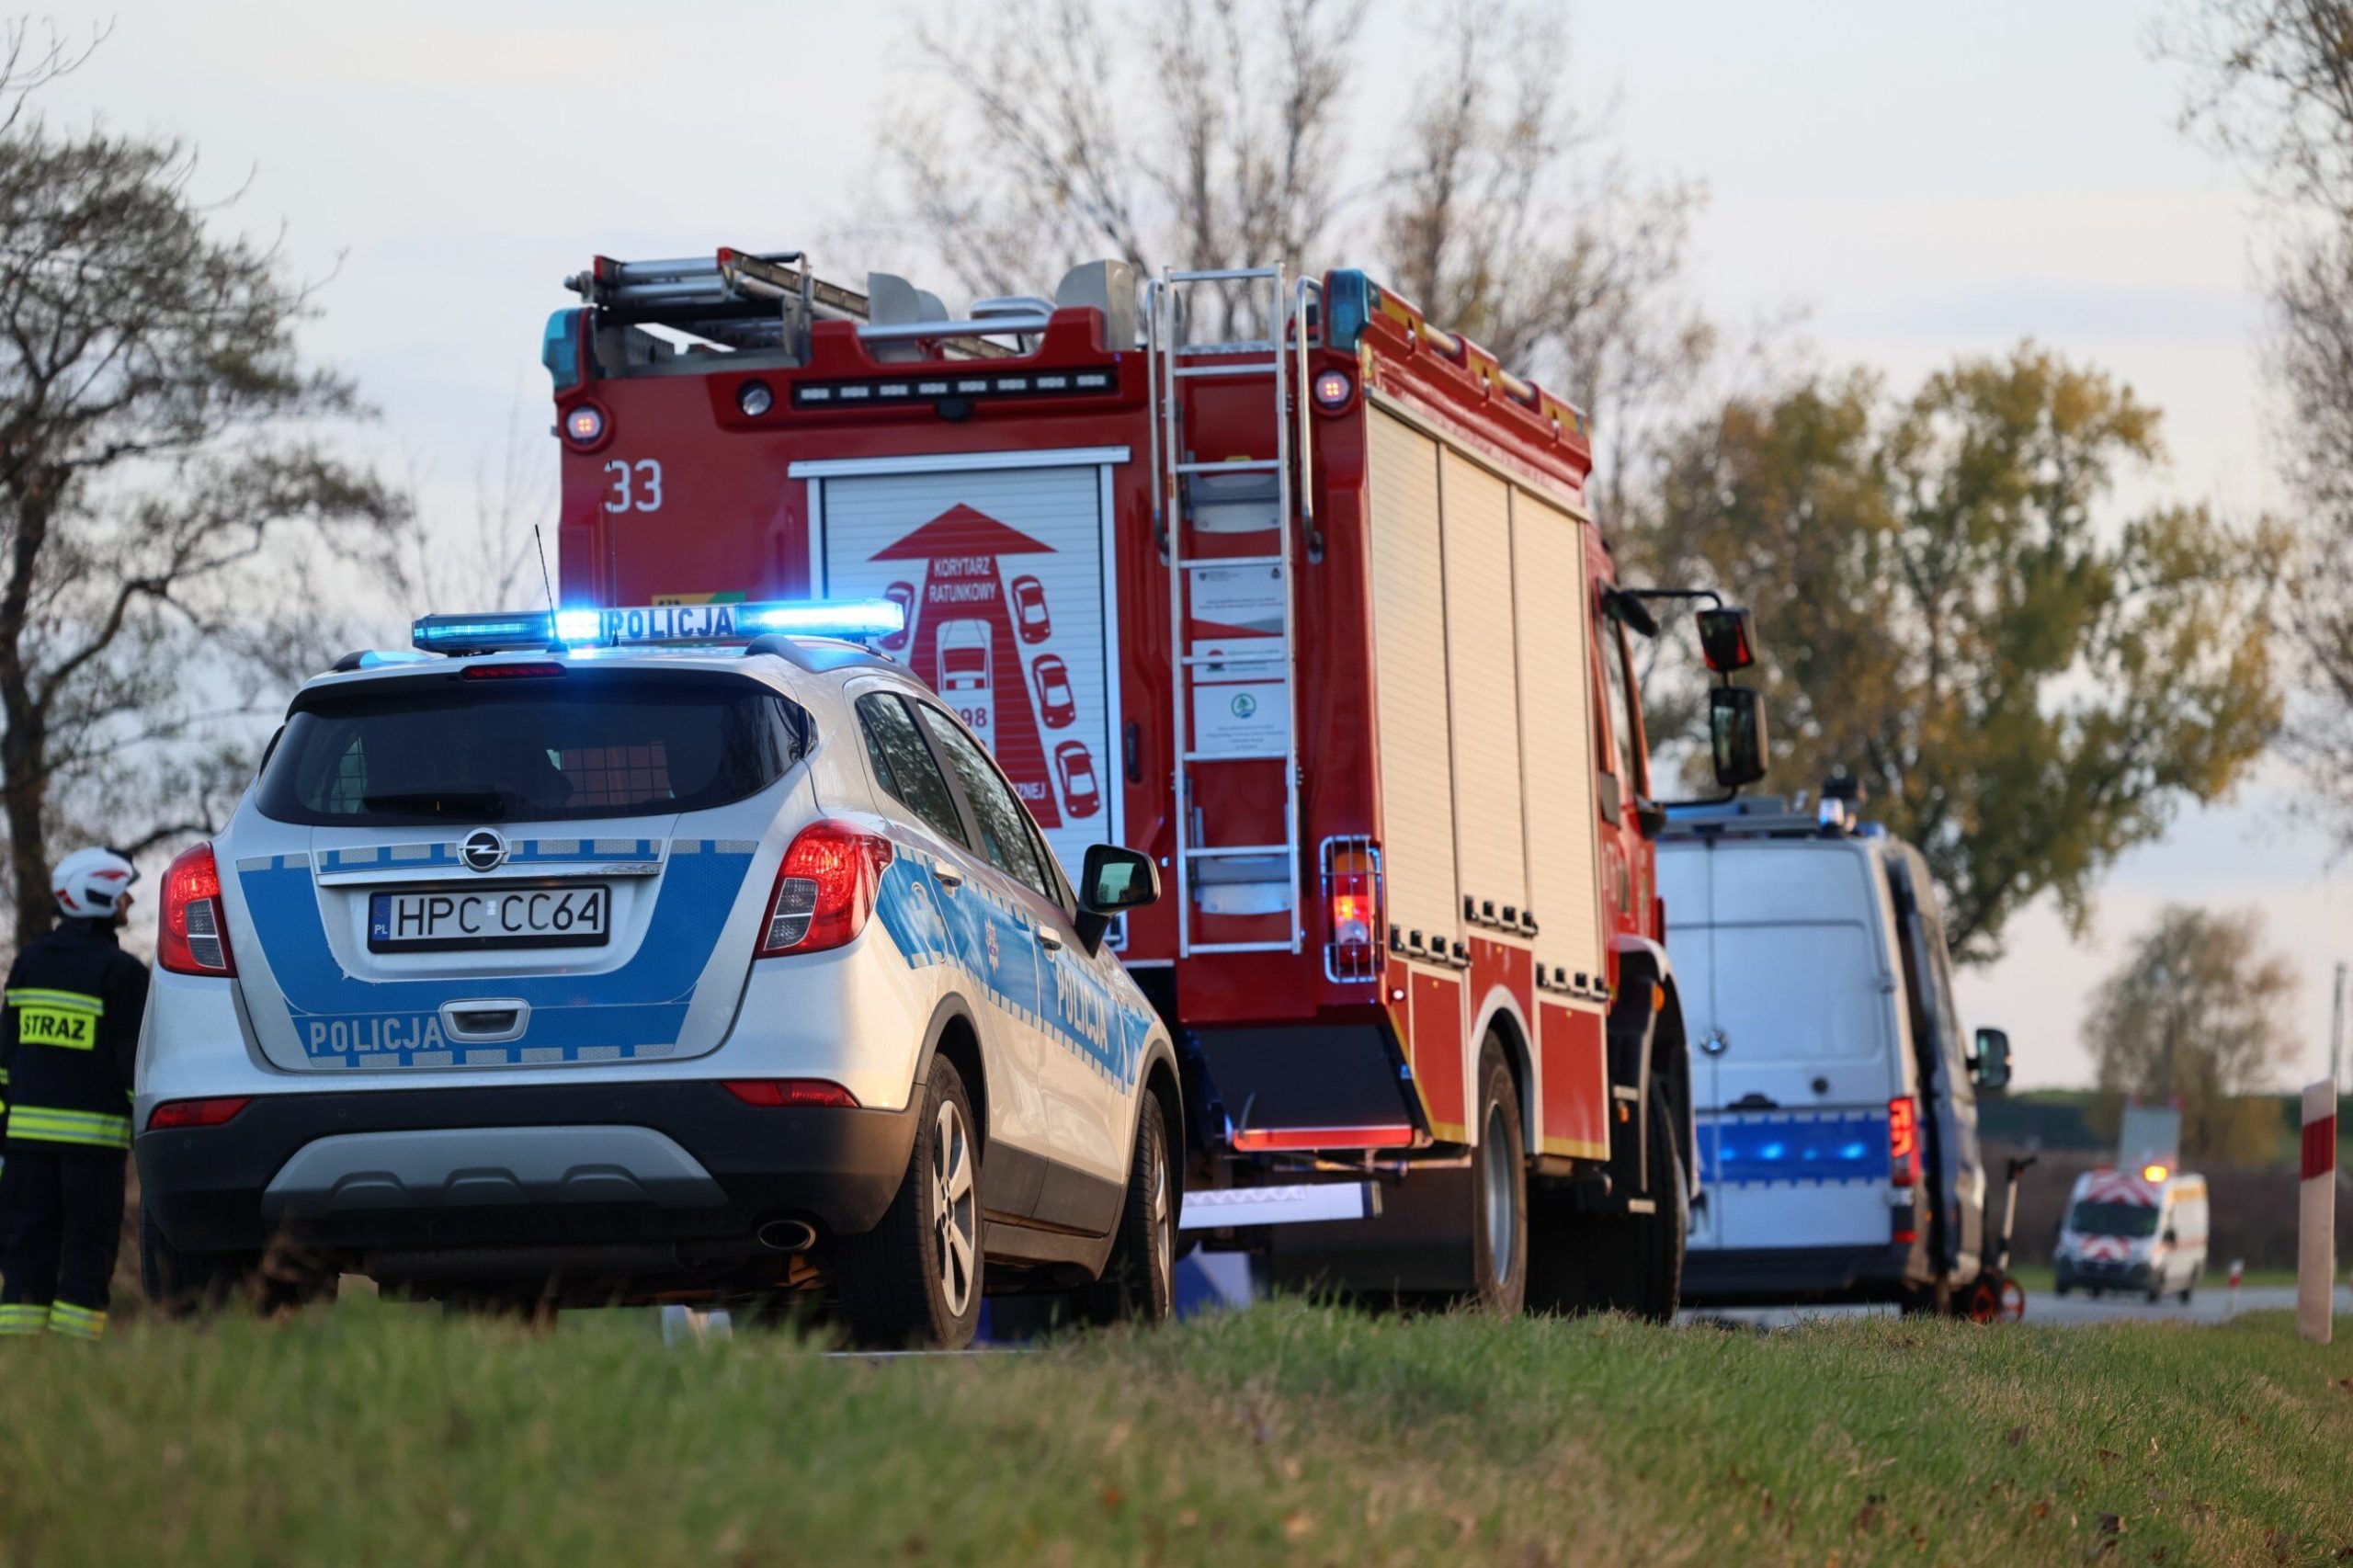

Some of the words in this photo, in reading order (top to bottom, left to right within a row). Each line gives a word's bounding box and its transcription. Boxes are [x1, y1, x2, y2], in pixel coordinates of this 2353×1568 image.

[604, 459, 662, 513] 33
[933, 556, 991, 577] KORYTARZ
[929, 582, 996, 603] RATUNKOWY
[608, 606, 733, 640] POLICJA
[955, 707, 987, 728] 98
[373, 924, 388, 935] PL
[397, 896, 482, 937] HPC
[501, 892, 600, 933] CC64
[1057, 960, 1108, 1054] POLICJA
[309, 1017, 446, 1054] POLICJA
